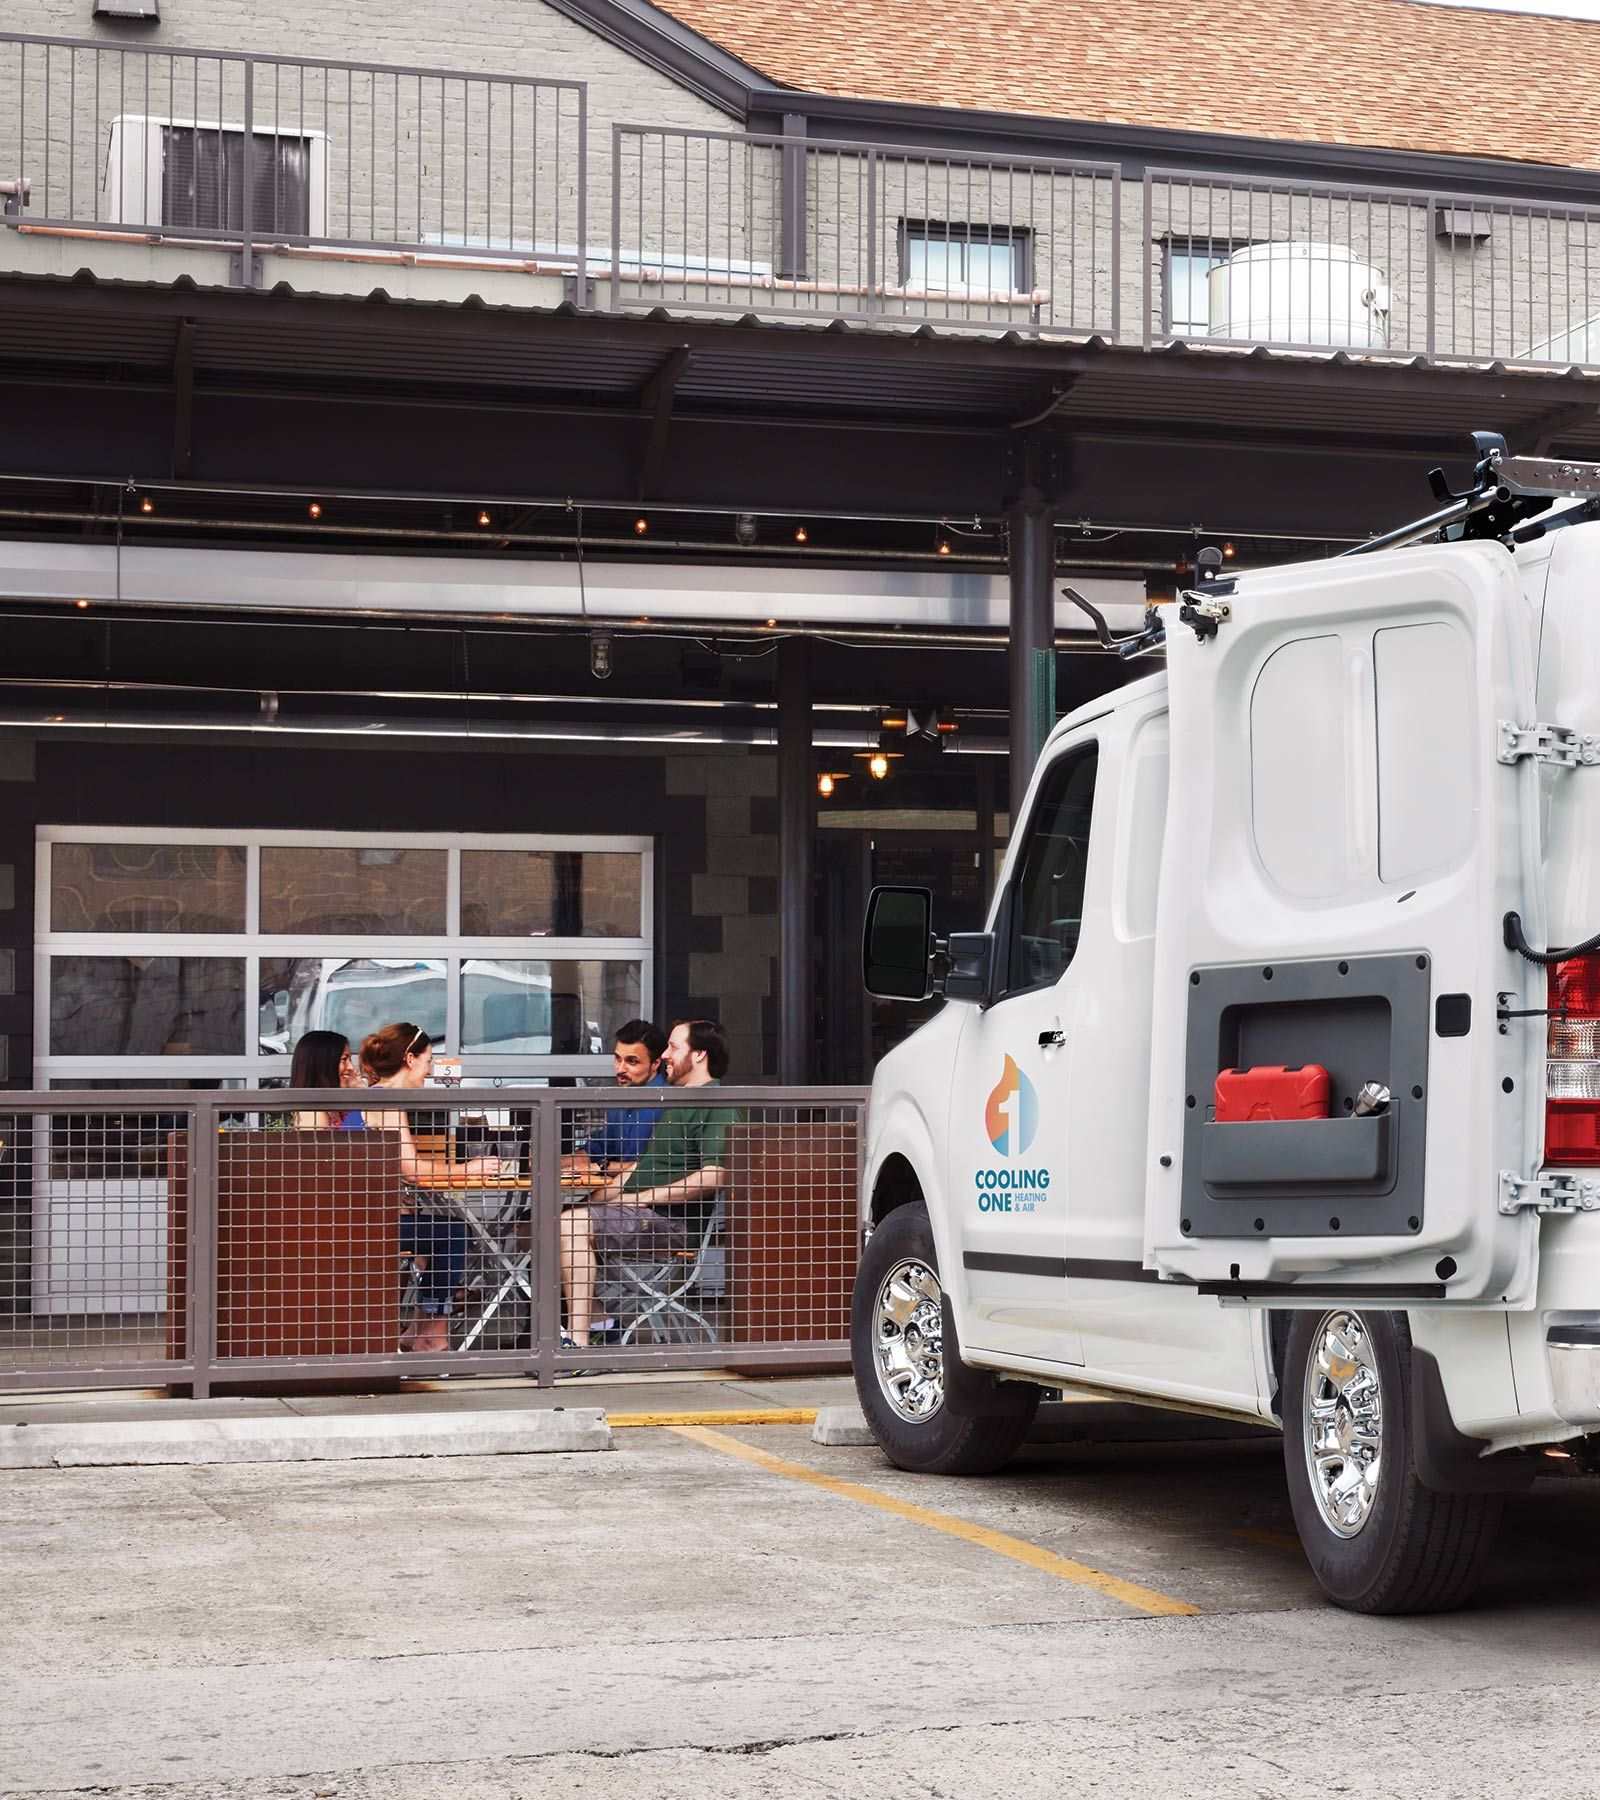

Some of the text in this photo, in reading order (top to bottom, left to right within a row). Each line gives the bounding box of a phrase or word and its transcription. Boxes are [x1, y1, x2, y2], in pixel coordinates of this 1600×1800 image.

[443, 1065, 452, 1076] 5
[975, 1169, 1050, 1189] COOLING
[978, 1192, 1012, 1212] ONE
[1014, 1193, 1047, 1202] HEATING
[1014, 1203, 1035, 1212] & AIR
